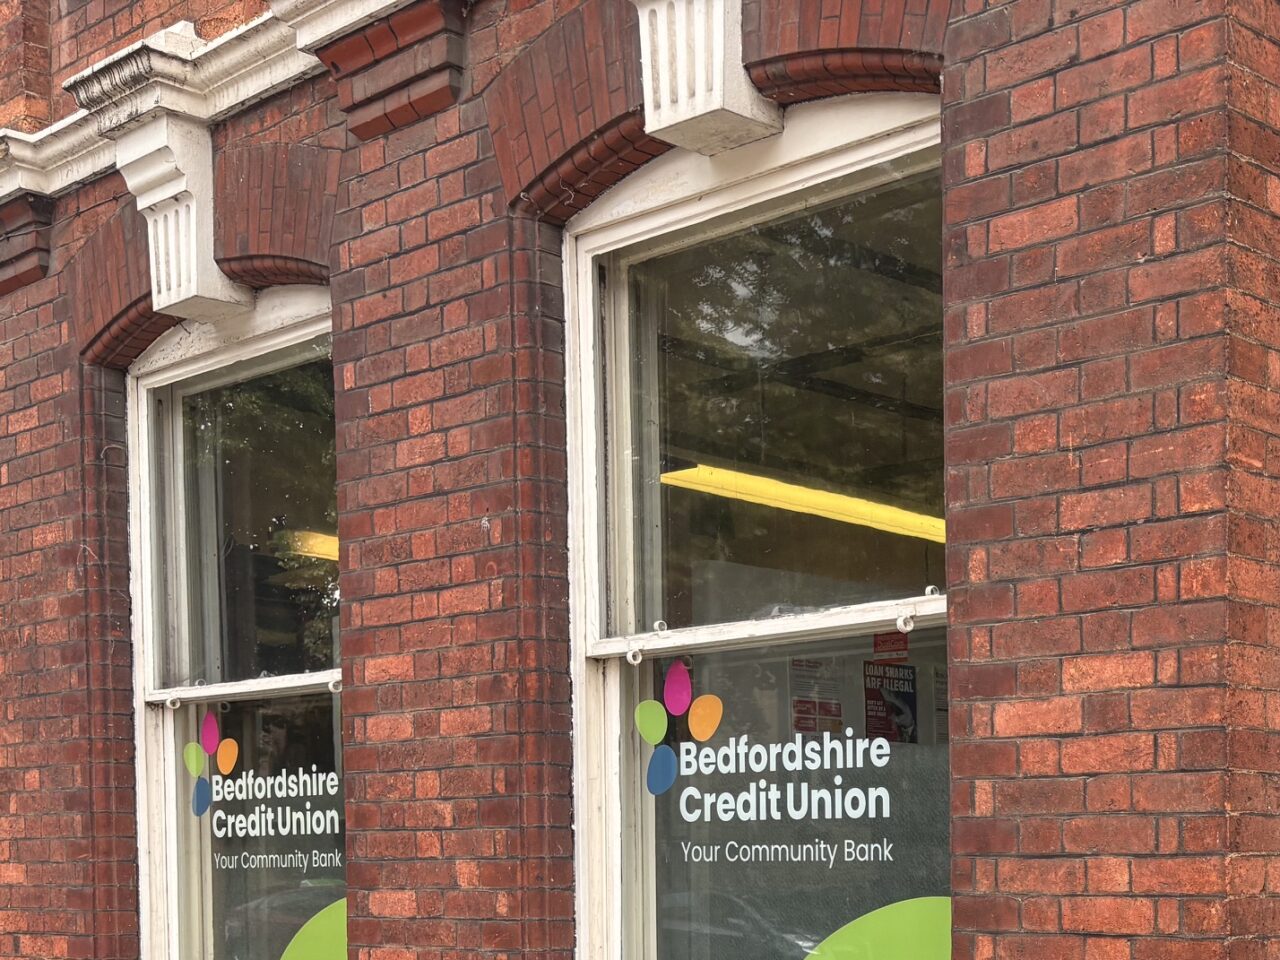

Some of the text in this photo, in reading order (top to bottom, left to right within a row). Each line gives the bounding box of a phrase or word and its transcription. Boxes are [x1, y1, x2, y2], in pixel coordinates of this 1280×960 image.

[866, 664, 914, 680] LOAN SHARKS
[884, 679, 914, 693] ILLEGAL
[680, 727, 891, 776] Bedfordshire
[212, 764, 339, 802] Bedfordshire
[680, 775, 890, 823] Credit Union
[213, 801, 340, 838] Credit Union
[214, 849, 342, 874] Your Community Bank
[681, 838, 894, 869] Your Community Bank
